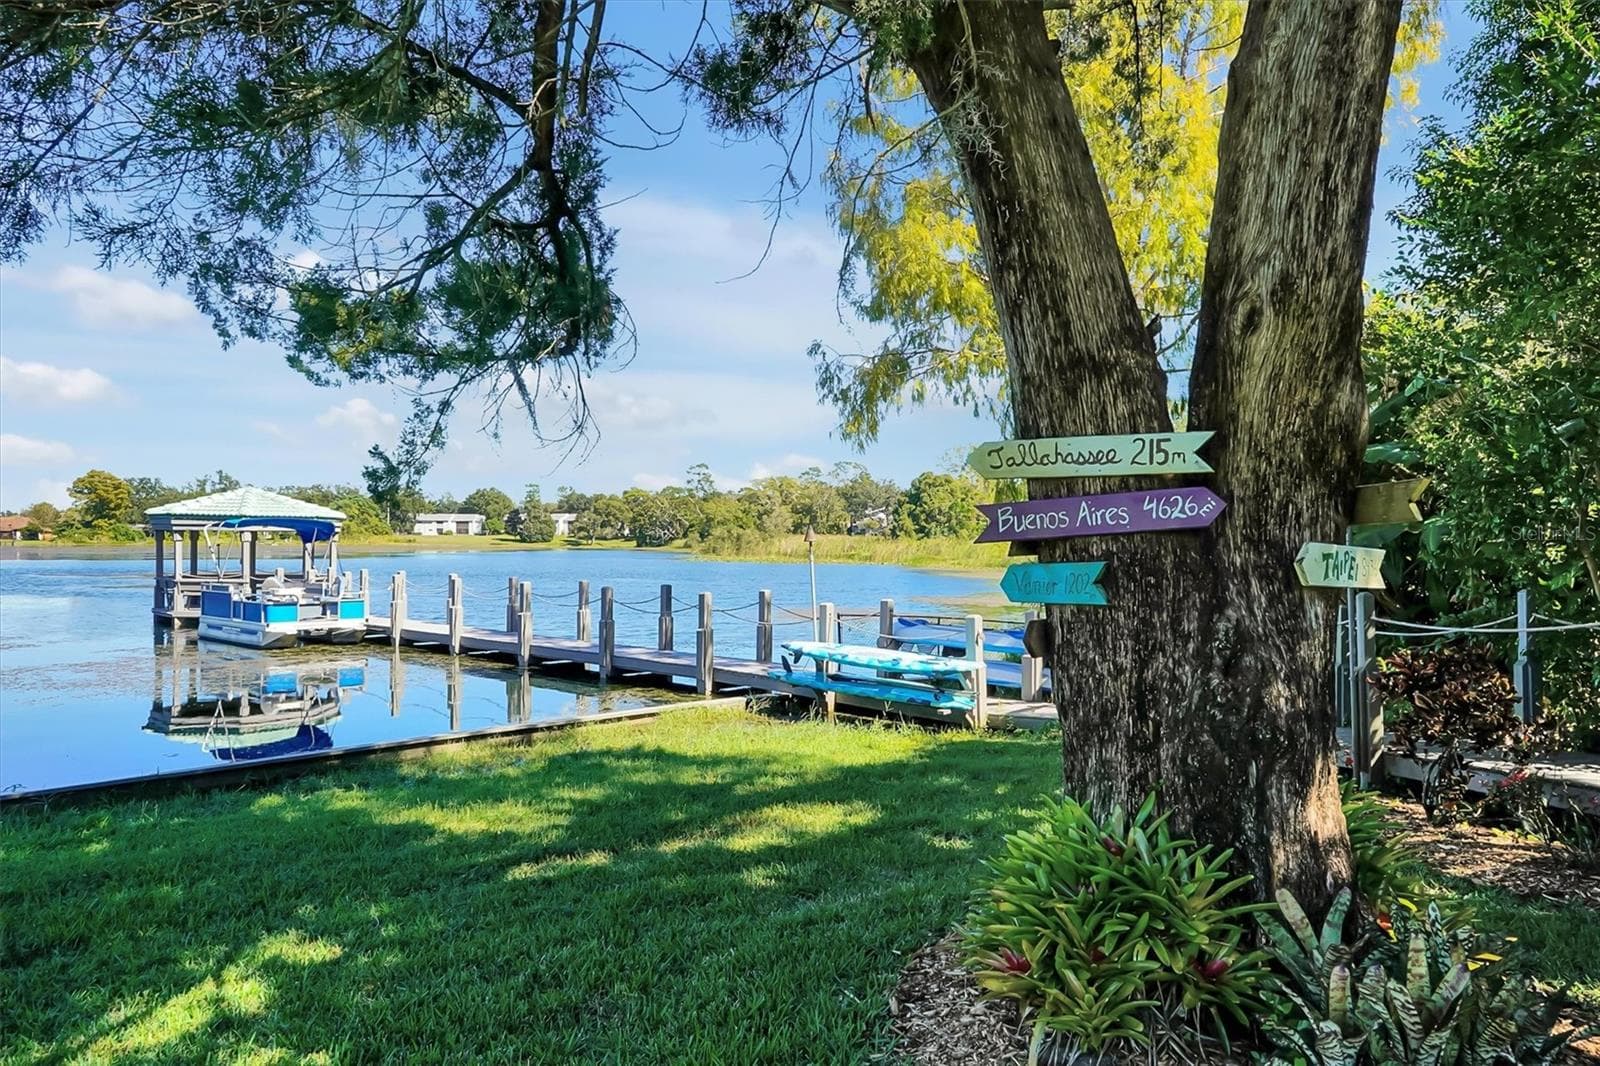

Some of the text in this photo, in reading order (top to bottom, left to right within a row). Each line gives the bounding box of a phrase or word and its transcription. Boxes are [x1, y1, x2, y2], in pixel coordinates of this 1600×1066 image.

[987, 441, 1122, 469] Tallahassee
[997, 505, 1069, 533] Buenos
[1076, 500, 1129, 528] Aires
[1322, 550, 1358, 581] TAIPEI
